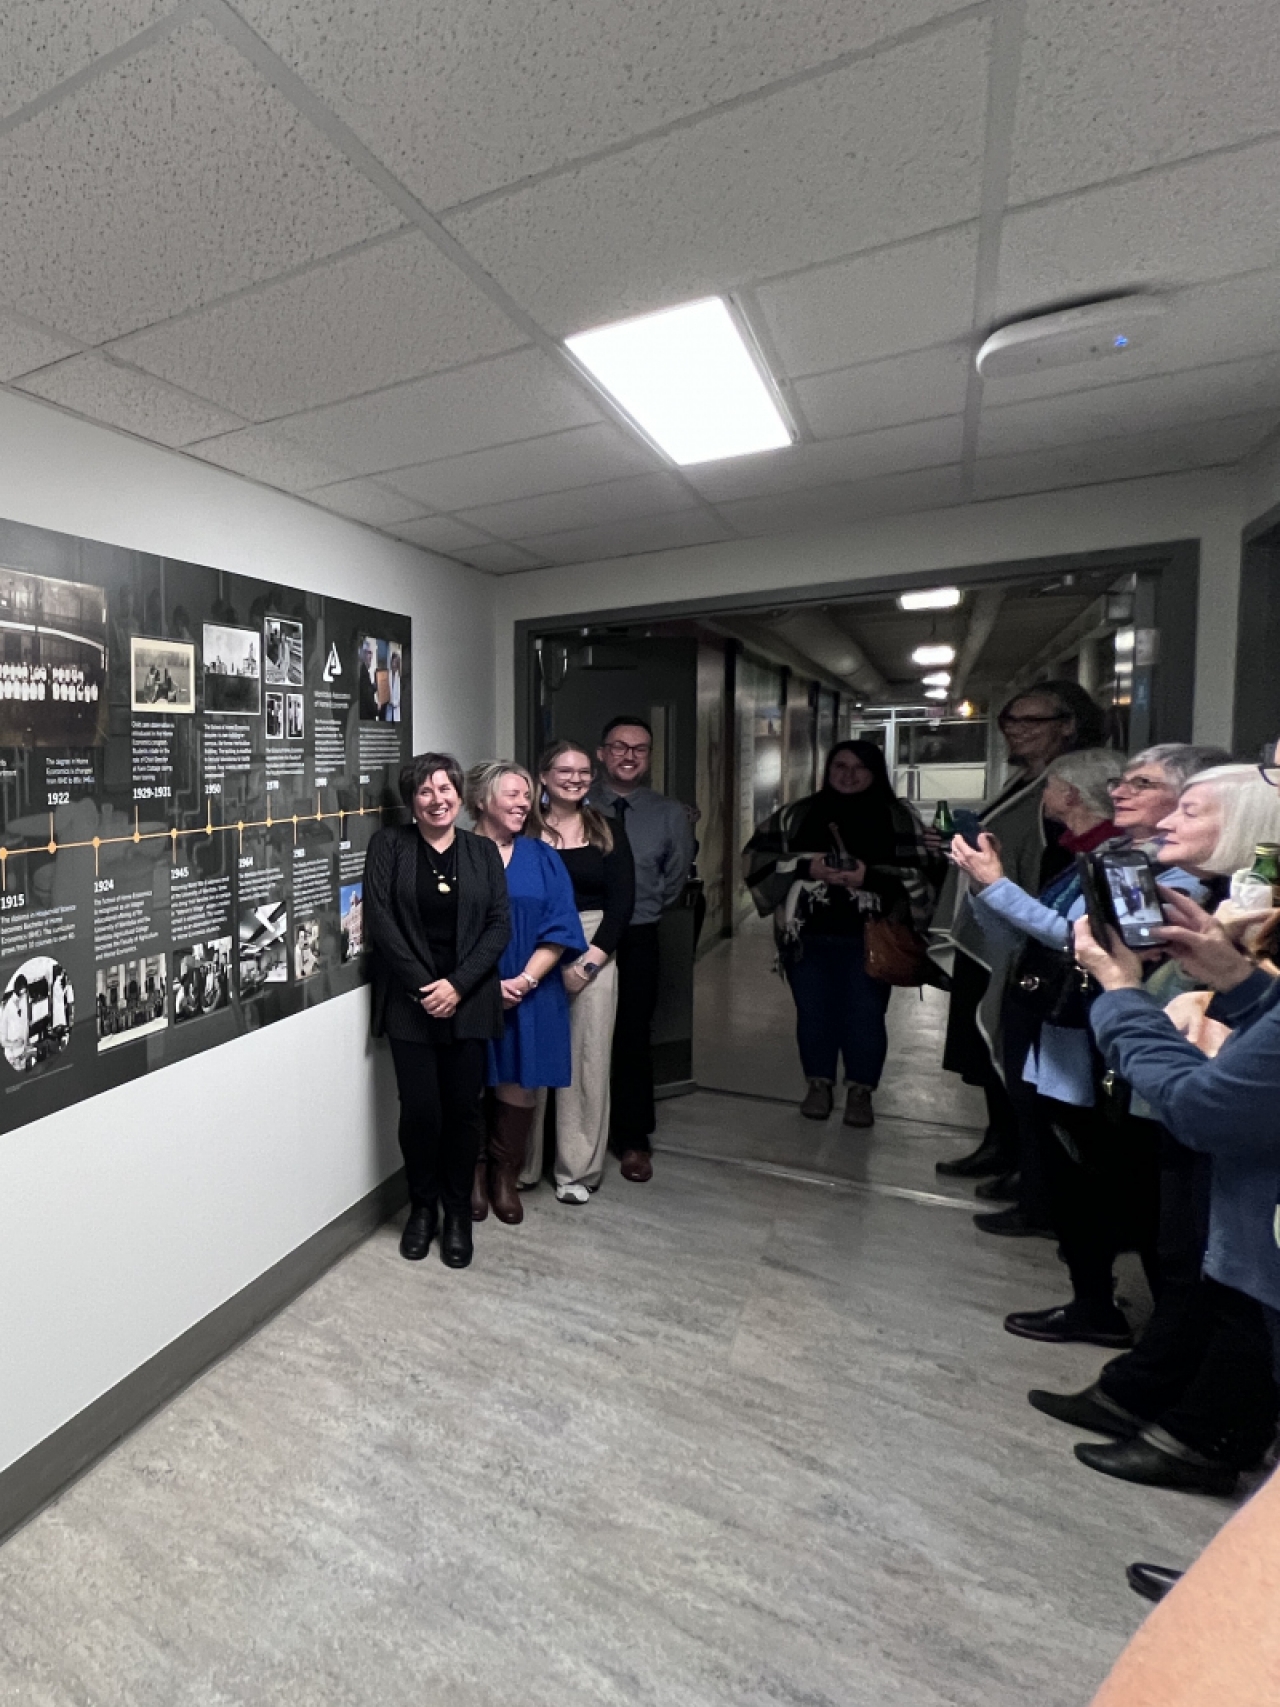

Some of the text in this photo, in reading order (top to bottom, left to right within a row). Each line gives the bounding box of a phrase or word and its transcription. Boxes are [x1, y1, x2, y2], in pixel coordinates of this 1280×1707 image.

[47, 792, 70, 805] 1922
[94, 879, 114, 893] 1924
[0, 894, 25, 910] 1915
